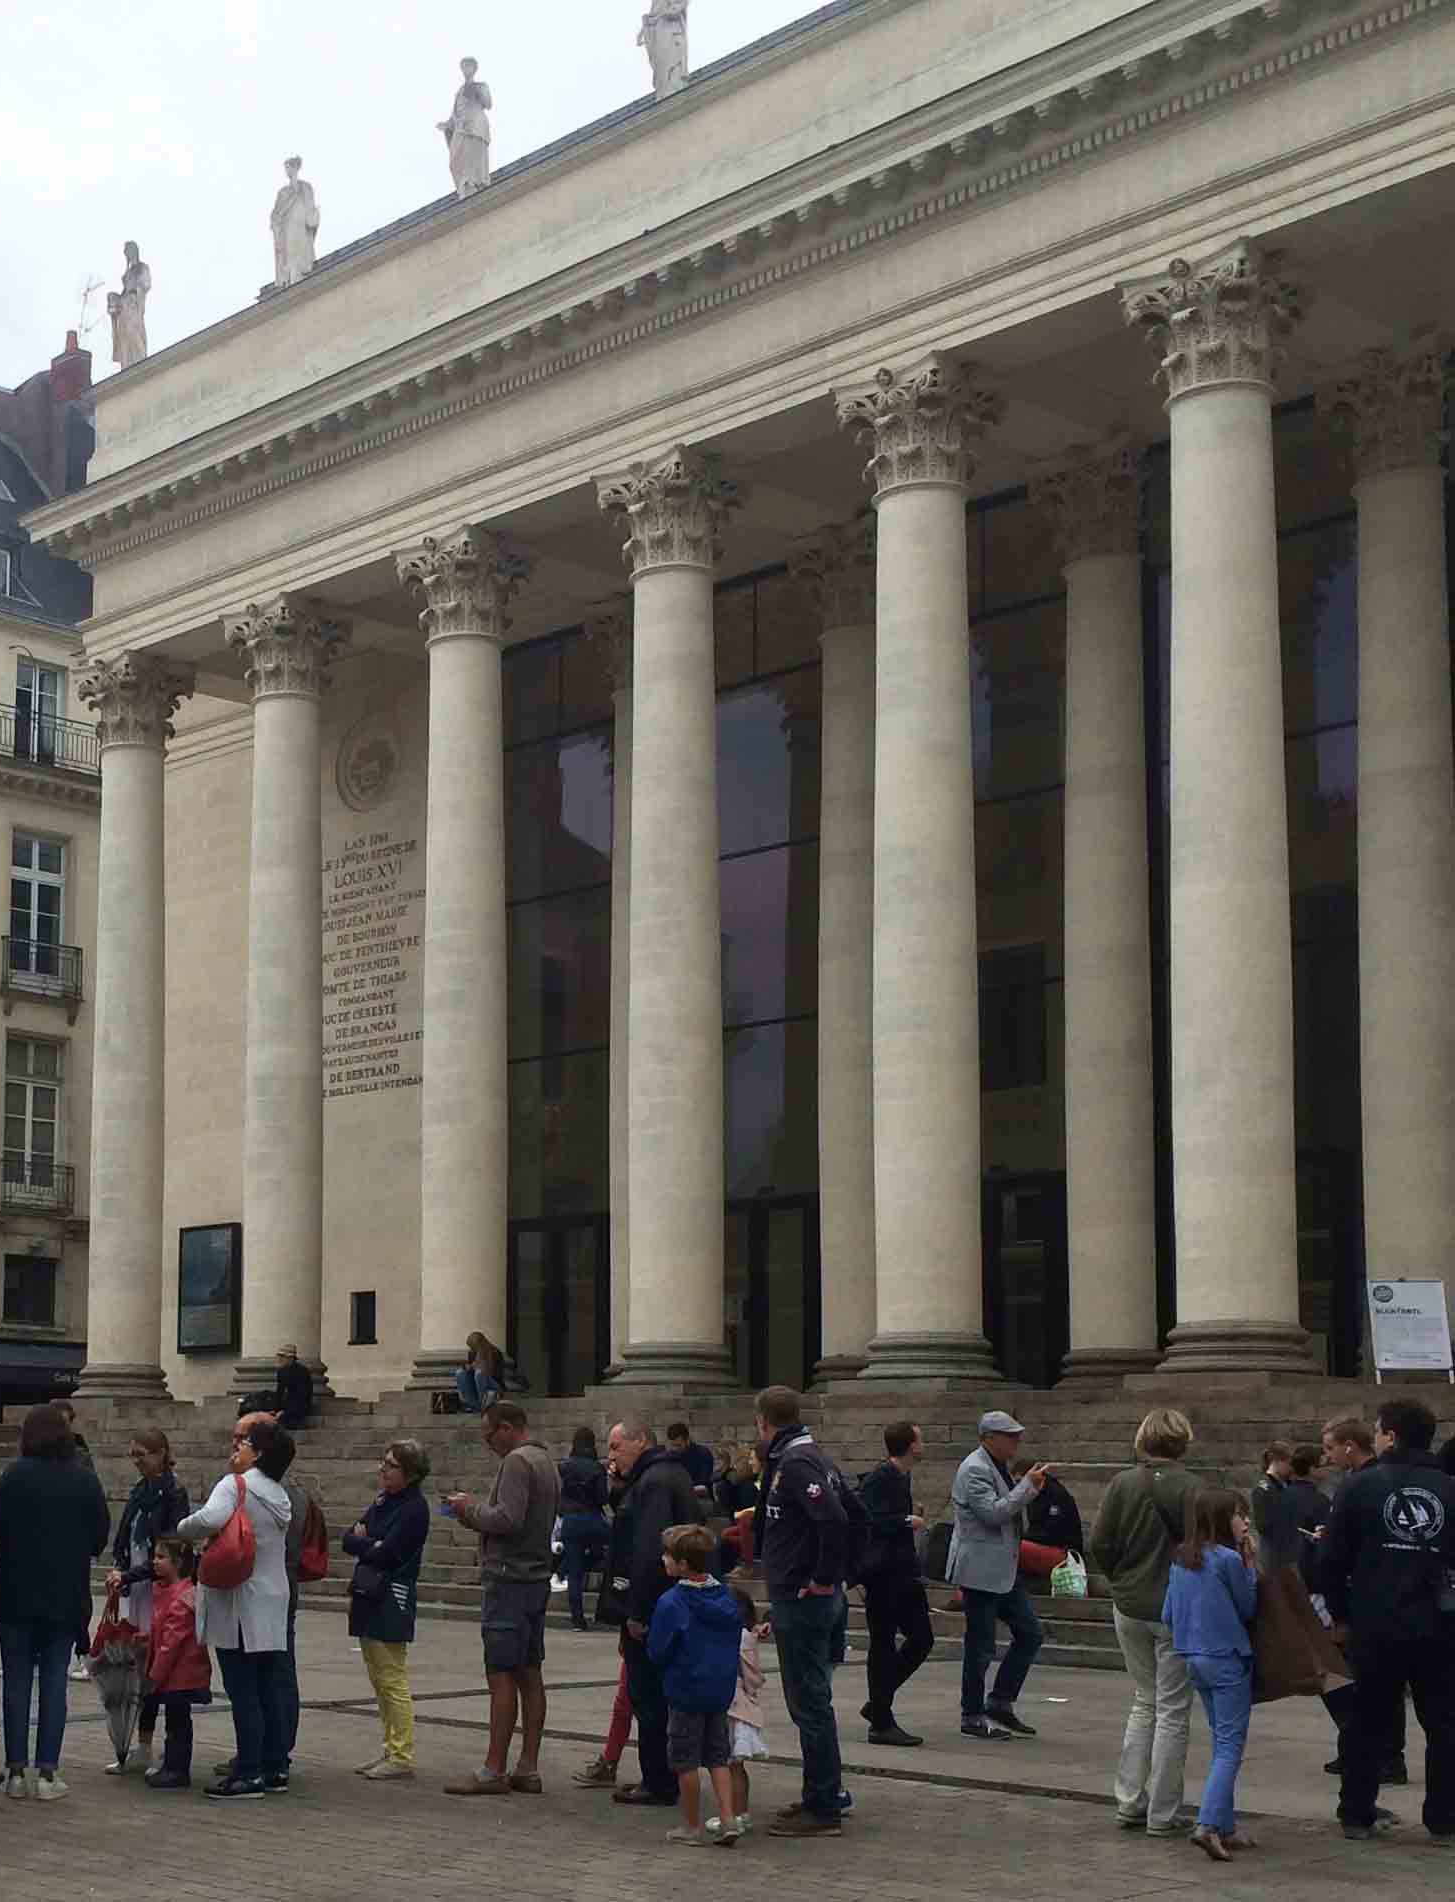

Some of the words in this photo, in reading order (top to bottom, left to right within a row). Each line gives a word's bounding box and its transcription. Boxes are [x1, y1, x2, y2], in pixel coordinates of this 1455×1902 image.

[334, 866, 374, 889] LOUIS
[377, 858, 402, 880] XVI
[336, 933, 350, 946] DE
[340, 948, 354, 961] DE
[333, 956, 400, 978] GOUVERNEUR
[322, 981, 351, 996] OMTE
[353, 978, 366, 991] DE
[329, 1071, 343, 1085] DE
[346, 1062, 401, 1081] BERTRAND
